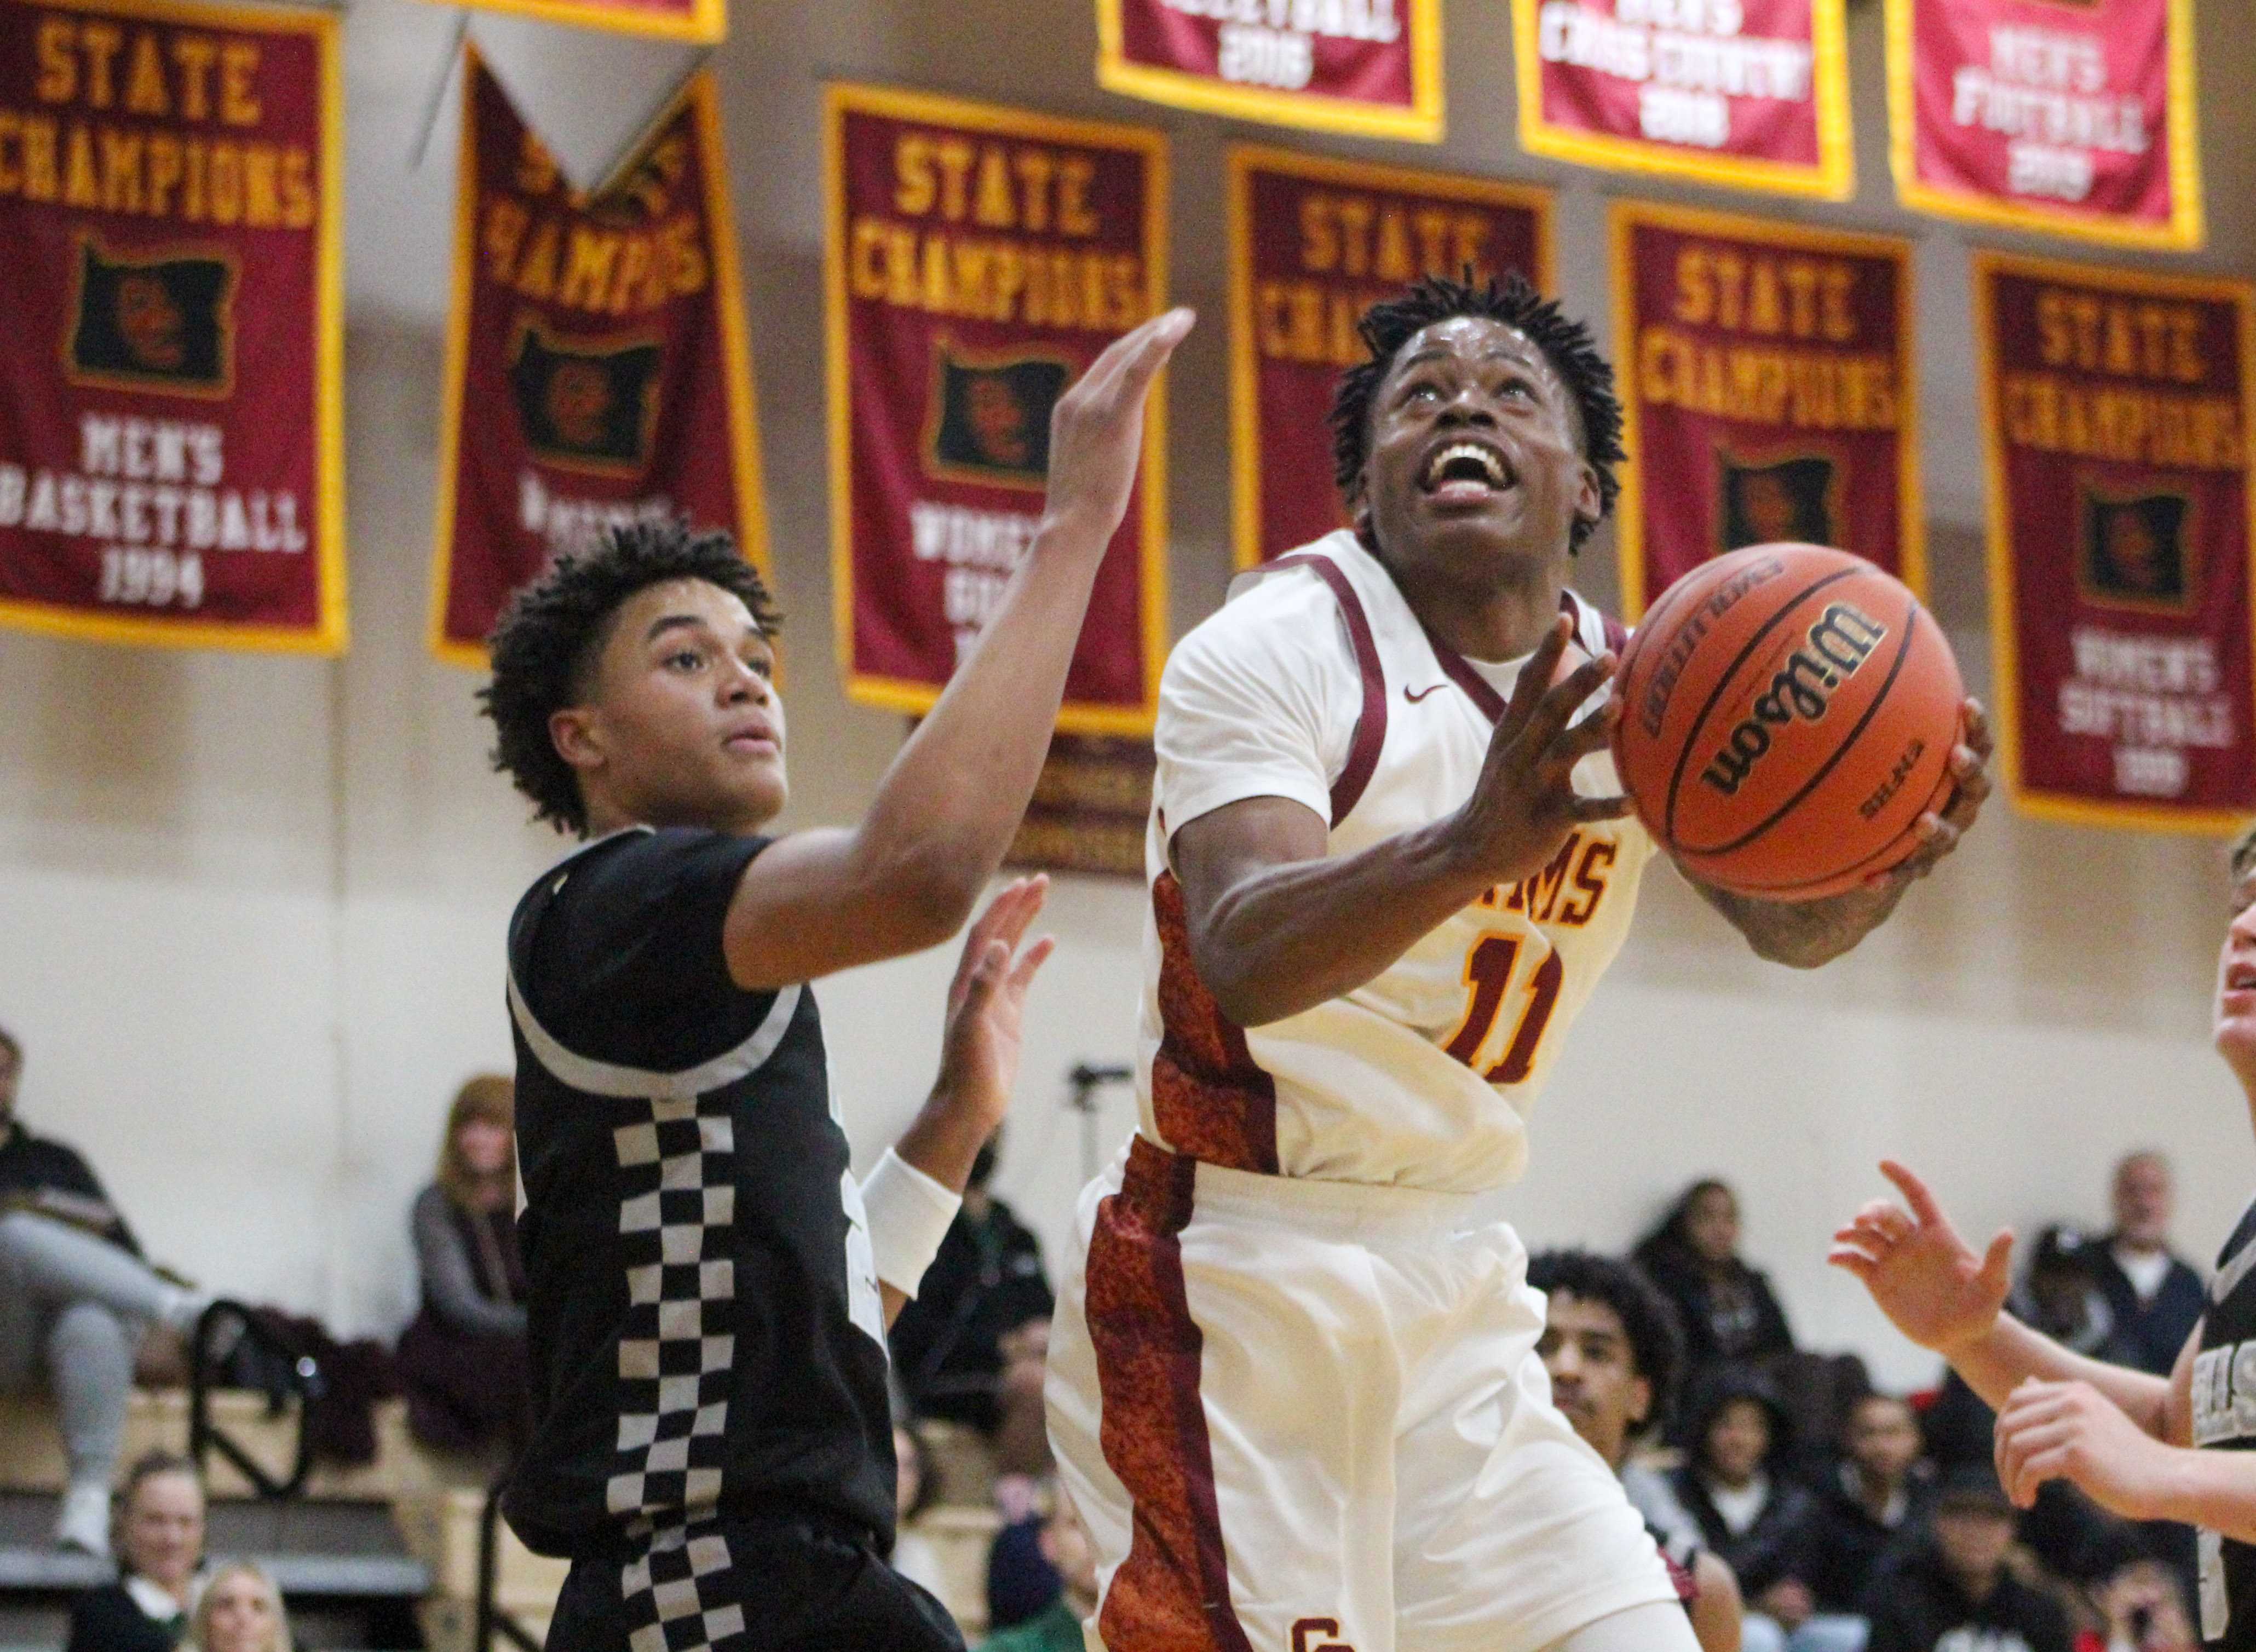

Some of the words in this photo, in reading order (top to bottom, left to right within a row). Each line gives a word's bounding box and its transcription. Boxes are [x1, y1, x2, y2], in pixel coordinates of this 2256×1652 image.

[35, 16, 260, 126] STATE
[1952, 62, 2148, 154] FOOTBALL
[894, 131, 1096, 235] STATE
[850, 219, 1154, 331] CHAMPIONS
[1673, 245, 1859, 342] STATE
[1642, 326, 1899, 433] CHAMPIONS
[2037, 290, 2208, 384] STATE
[81, 413, 223, 485] MEN'S
[0, 465, 307, 553] BASKETBALL
[101, 548, 204, 608] 1994
[1701, 601, 1889, 796] Wilson
[2059, 676, 2234, 750] SOFTBALL
